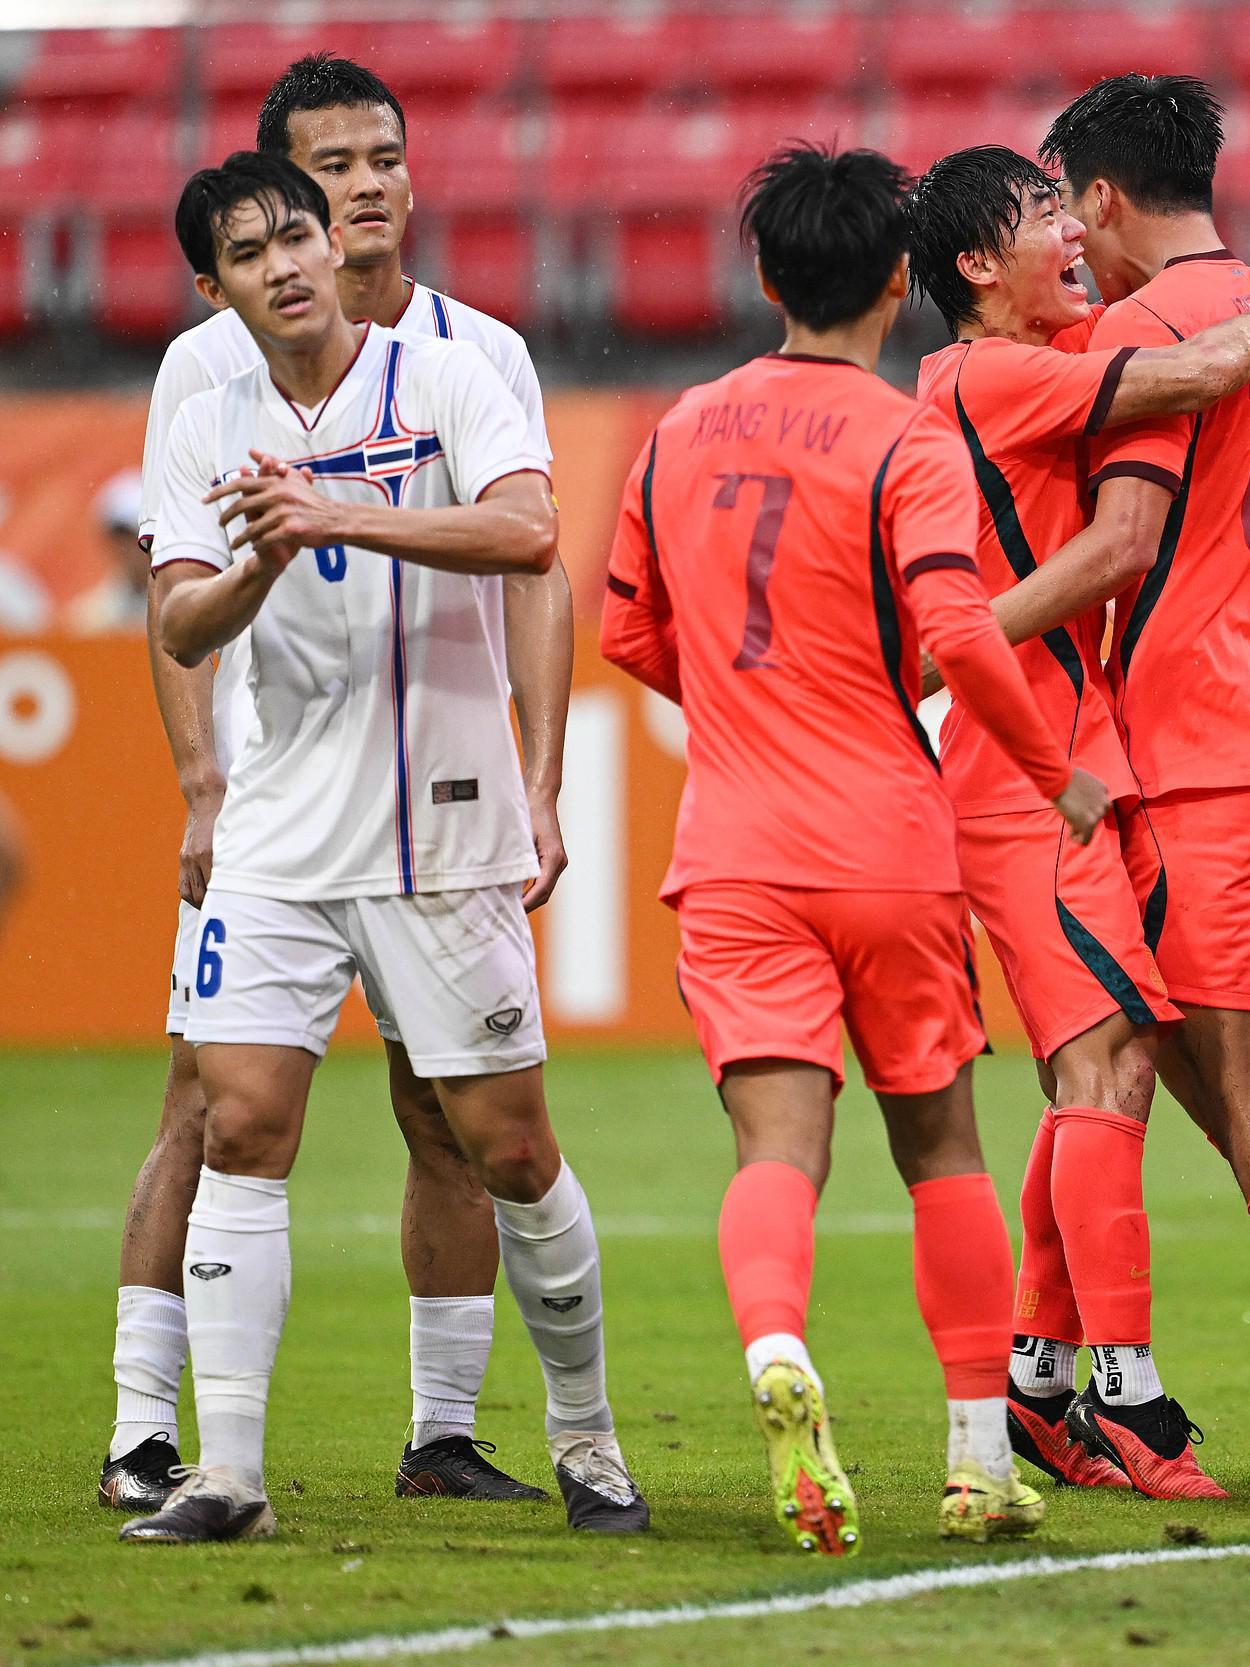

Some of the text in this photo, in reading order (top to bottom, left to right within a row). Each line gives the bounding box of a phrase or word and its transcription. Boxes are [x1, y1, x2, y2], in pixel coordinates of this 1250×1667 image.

[688, 403, 849, 454] XIANG Y W
[711, 473, 794, 672] 7
[196, 918, 227, 998] 6
